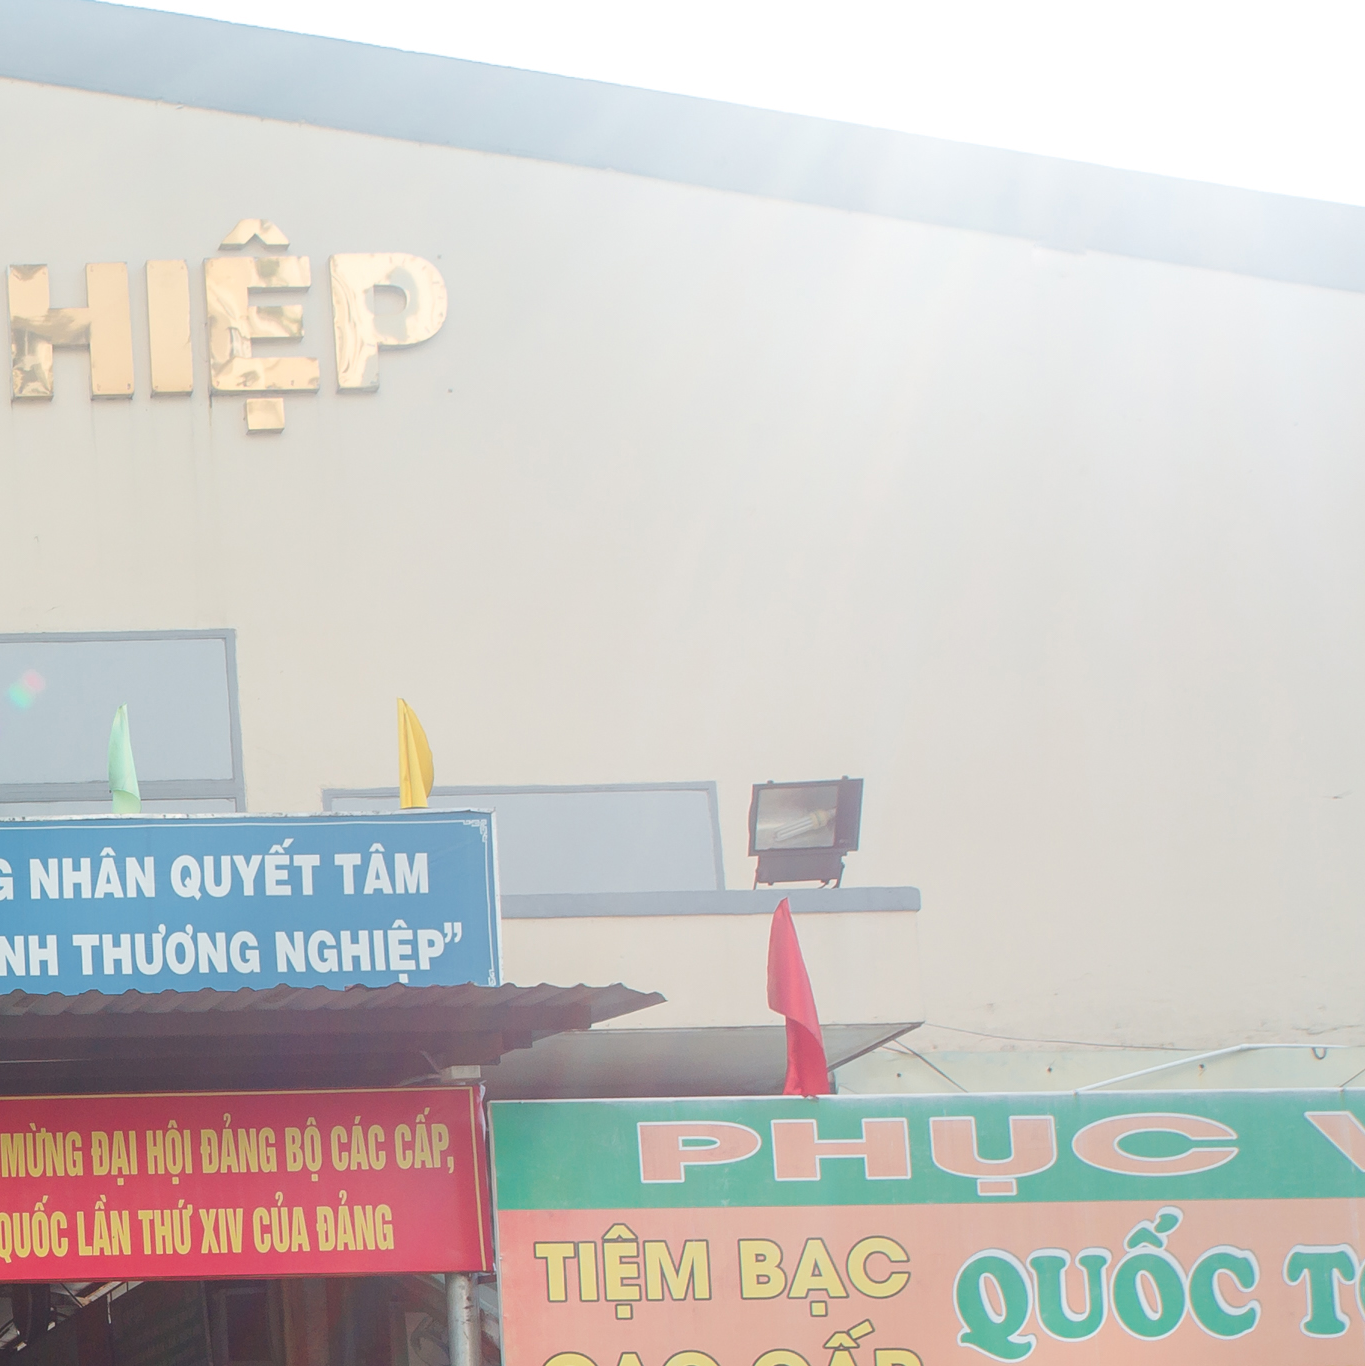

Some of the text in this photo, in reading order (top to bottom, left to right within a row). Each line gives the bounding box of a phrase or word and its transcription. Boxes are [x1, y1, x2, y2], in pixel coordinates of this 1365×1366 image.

[7, 217, 449, 436] HIỆP
[30, 847, 156, 900] NHÂN
[170, 838, 320, 901] QUYẾT
[335, 844, 430, 895] TÂM
[73, 923, 261, 977] THƯƠNG
[0, 1120, 83, 1178] MỪNG
[91, 1130, 137, 1187] ĐẠI
[146, 1118, 193, 1185] HỘI
[200, 1111, 278, 1176] ĐẢNG
[286, 1116, 323, 1182] BỘ
[330, 1114, 387, 1172] CÁC
[394, 1105, 456, 1174] CẤP,
[635, 1110, 1240, 1197] PHỤC
[77, 1193, 132, 1256] LẦN
[141, 1199, 194, 1255] THỨ
[200, 1206, 244, 1253] XIV
[252, 1190, 309, 1253] CỦA
[316, 1188, 395, 1251] ĐẢNG
[534, 1223, 911, 1321] TIỆM BẠC
[952, 1206, 1365, 1364] QUỐC T
